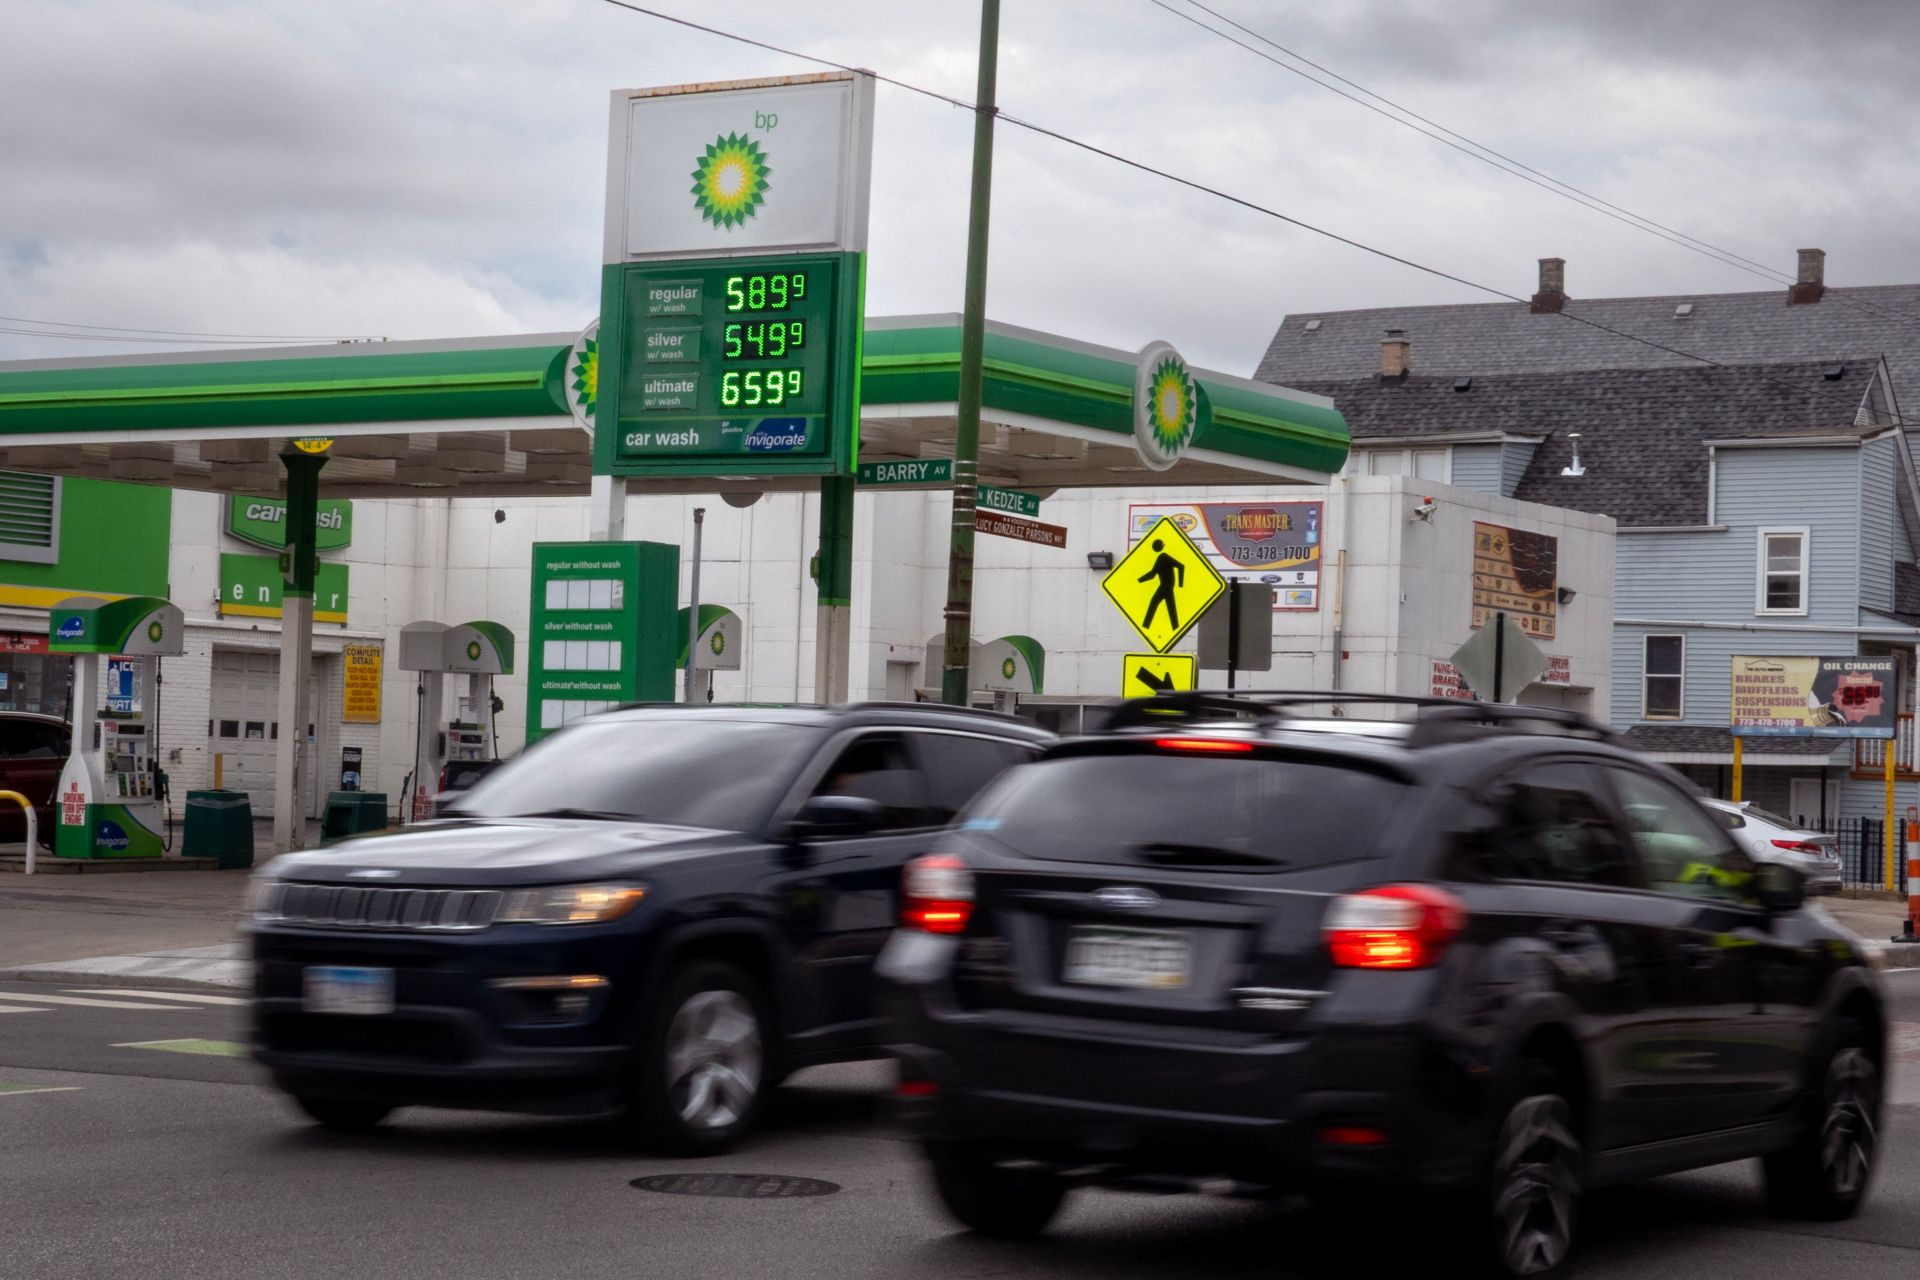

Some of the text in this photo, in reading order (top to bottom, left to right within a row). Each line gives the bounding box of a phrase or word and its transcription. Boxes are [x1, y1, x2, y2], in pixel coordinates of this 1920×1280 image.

[755, 110, 778, 133] bp
[650, 286, 698, 303] regular
[650, 303, 686, 313] w/ wash
[648, 333, 684, 347] silver
[648, 350, 684, 360] w/ wash
[644, 379, 695, 393] ultimate
[644, 397, 681, 407] w/ wash
[626, 428, 699, 447] car wash
[744, 432, 806, 449] Invigorate
[864, 463, 946, 481] W BARRY AV
[986, 489, 1024, 512] KEDZIE
[1027, 501, 1036, 510] AV
[246, 503, 287, 522] car
[1226, 514, 1253, 531] TRANS
[1254, 512, 1289, 530] MASTER
[975, 518, 993, 532] LUCY
[993, 521, 1024, 538] GONZALEZ
[1025, 528, 1054, 544] PARSONS
[1231, 545, 1311, 561] 773-478-1700
[546, 560, 621, 571] regular without wash
[544, 622, 613, 631] silver without wash
[346, 647, 381, 657] COMPLETE
[352, 656, 374, 665] DETAIL
[1823, 662, 1893, 671] OIL CHANGE
[1735, 674, 1785, 683] BRAKES
[542, 680, 621, 690] ultimate without wash
[1735, 686, 1799, 695] MUFFLERS
[1735, 697, 1807, 708] SUSPENSIONS
[1735, 707, 1771, 717] TIRES
